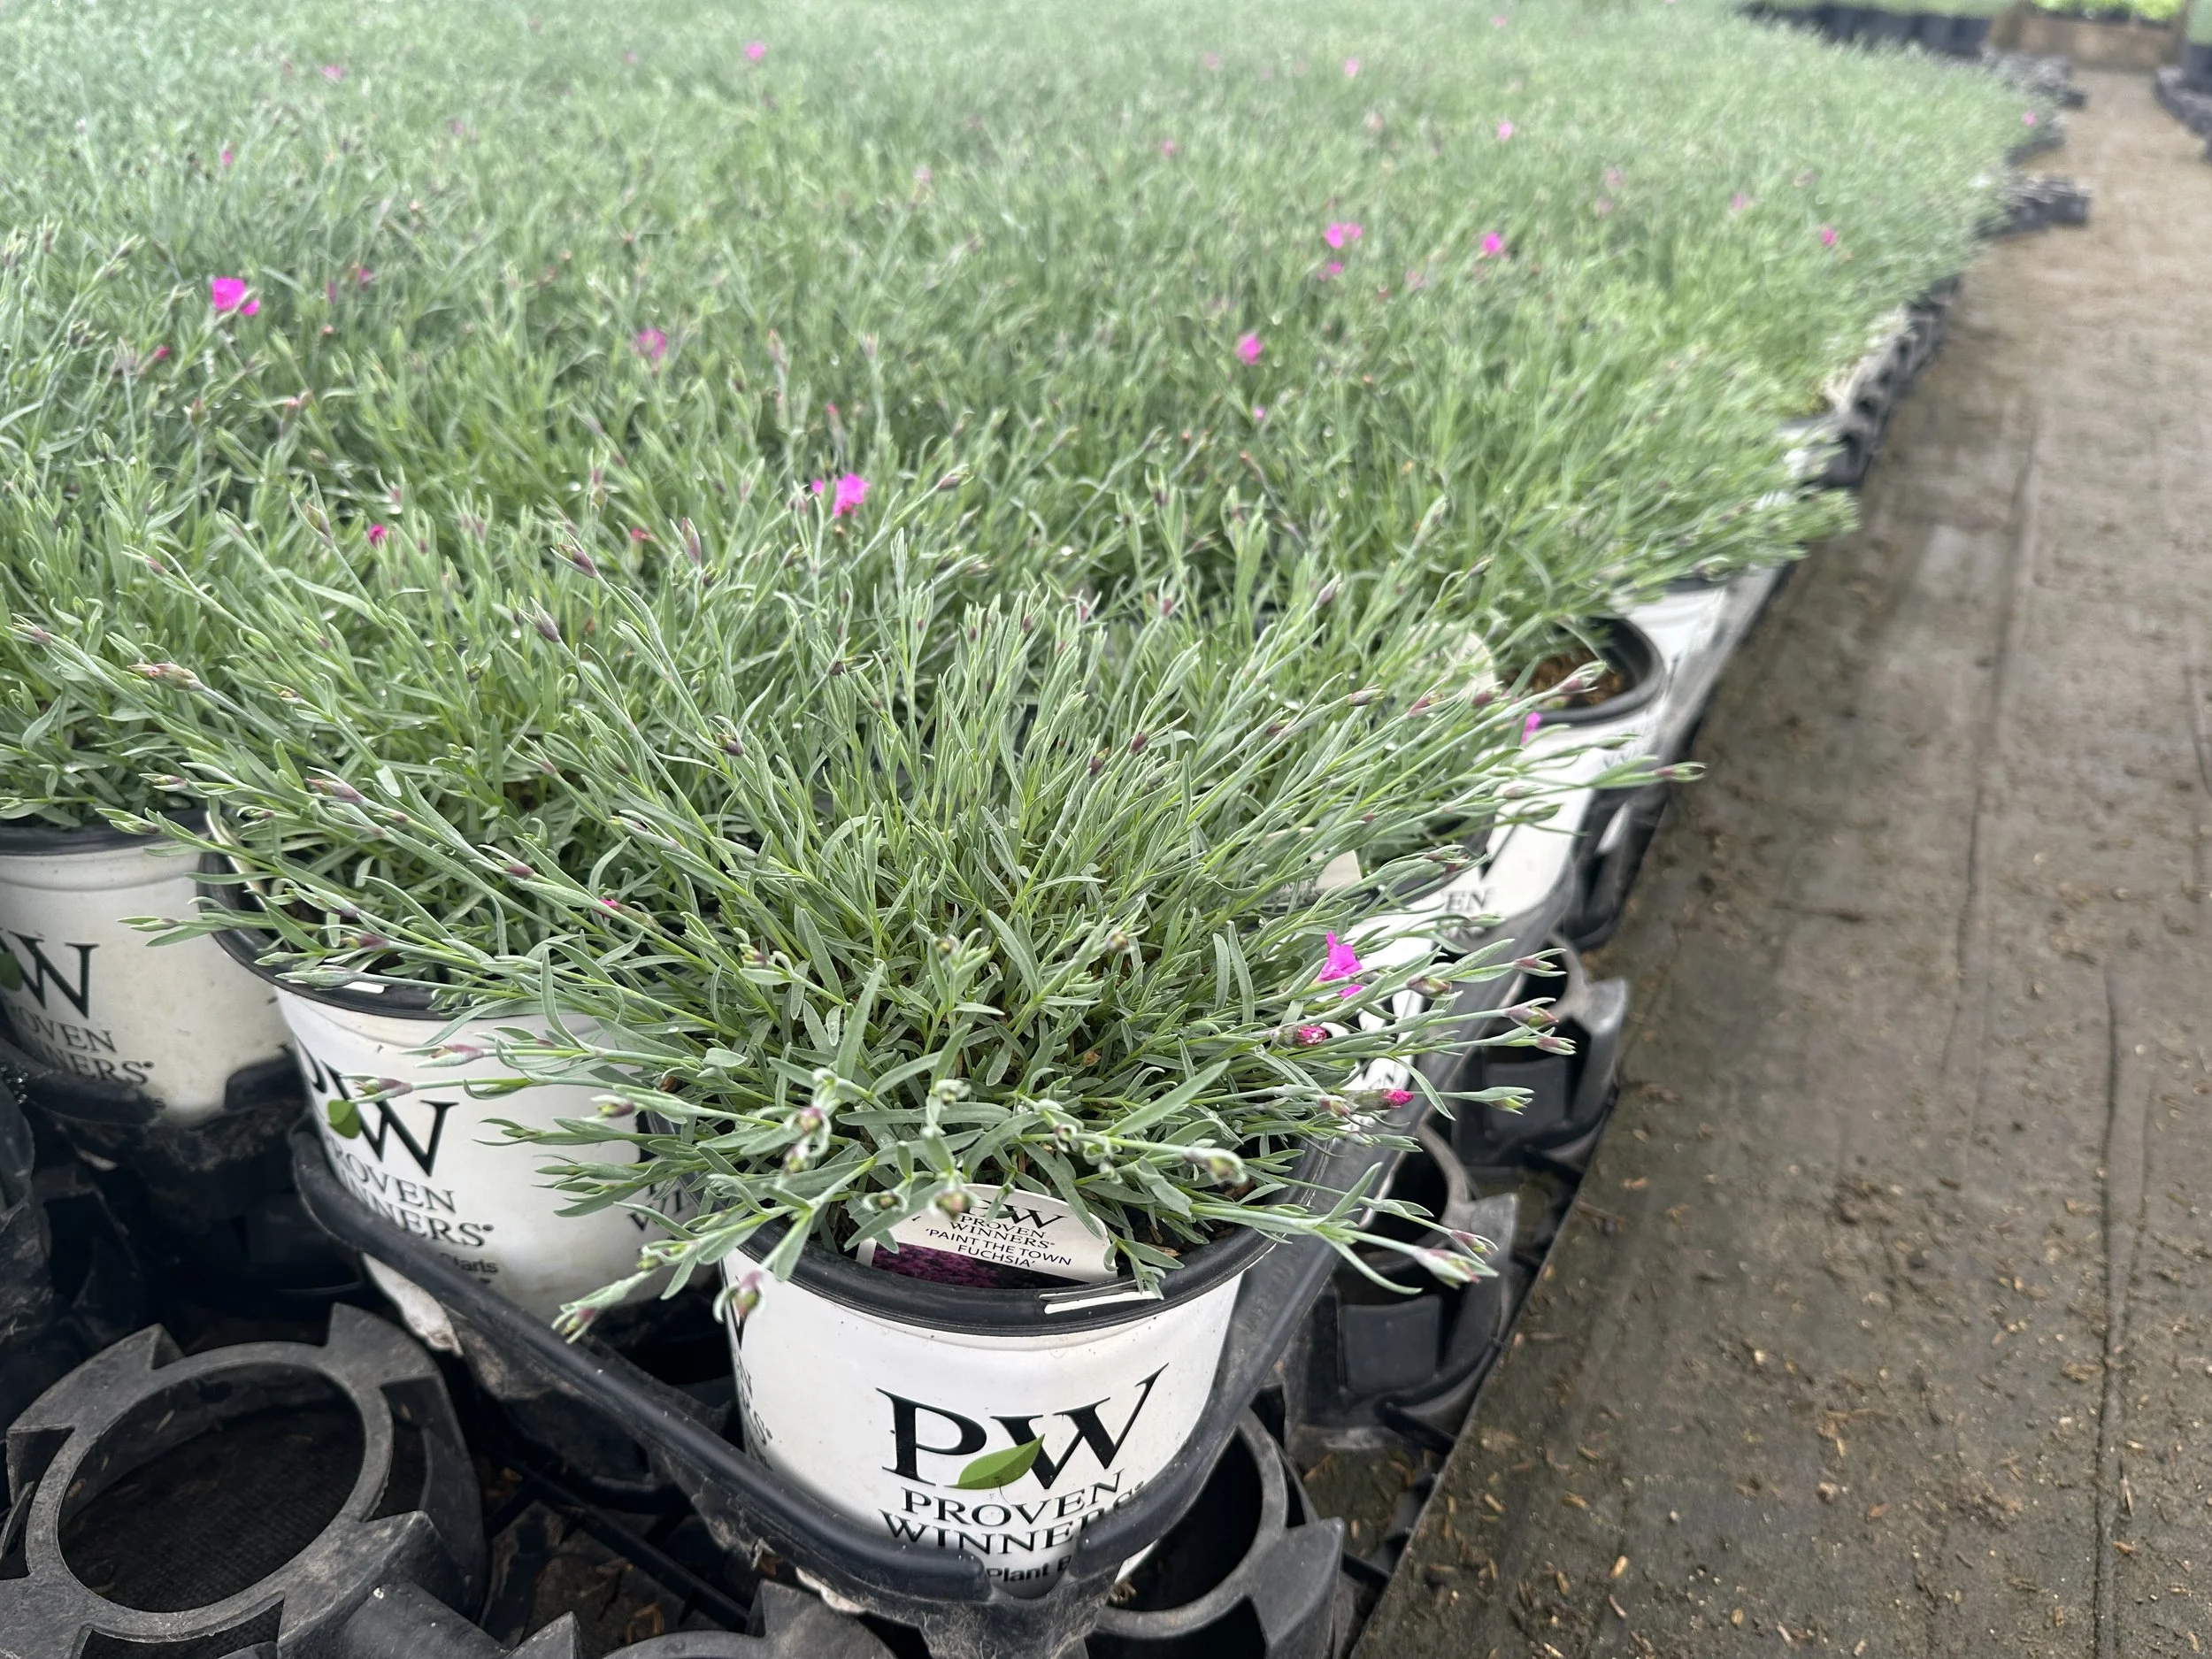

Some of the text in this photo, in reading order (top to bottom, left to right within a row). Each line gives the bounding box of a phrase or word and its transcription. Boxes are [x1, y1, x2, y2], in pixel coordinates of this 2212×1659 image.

[960, 1215, 1046, 1239] PROVEN
[983, 1240, 1015, 1255] THE
[1019, 1248, 1072, 1266] TOWN
[901, 1468, 1125, 1525] PROVEN
